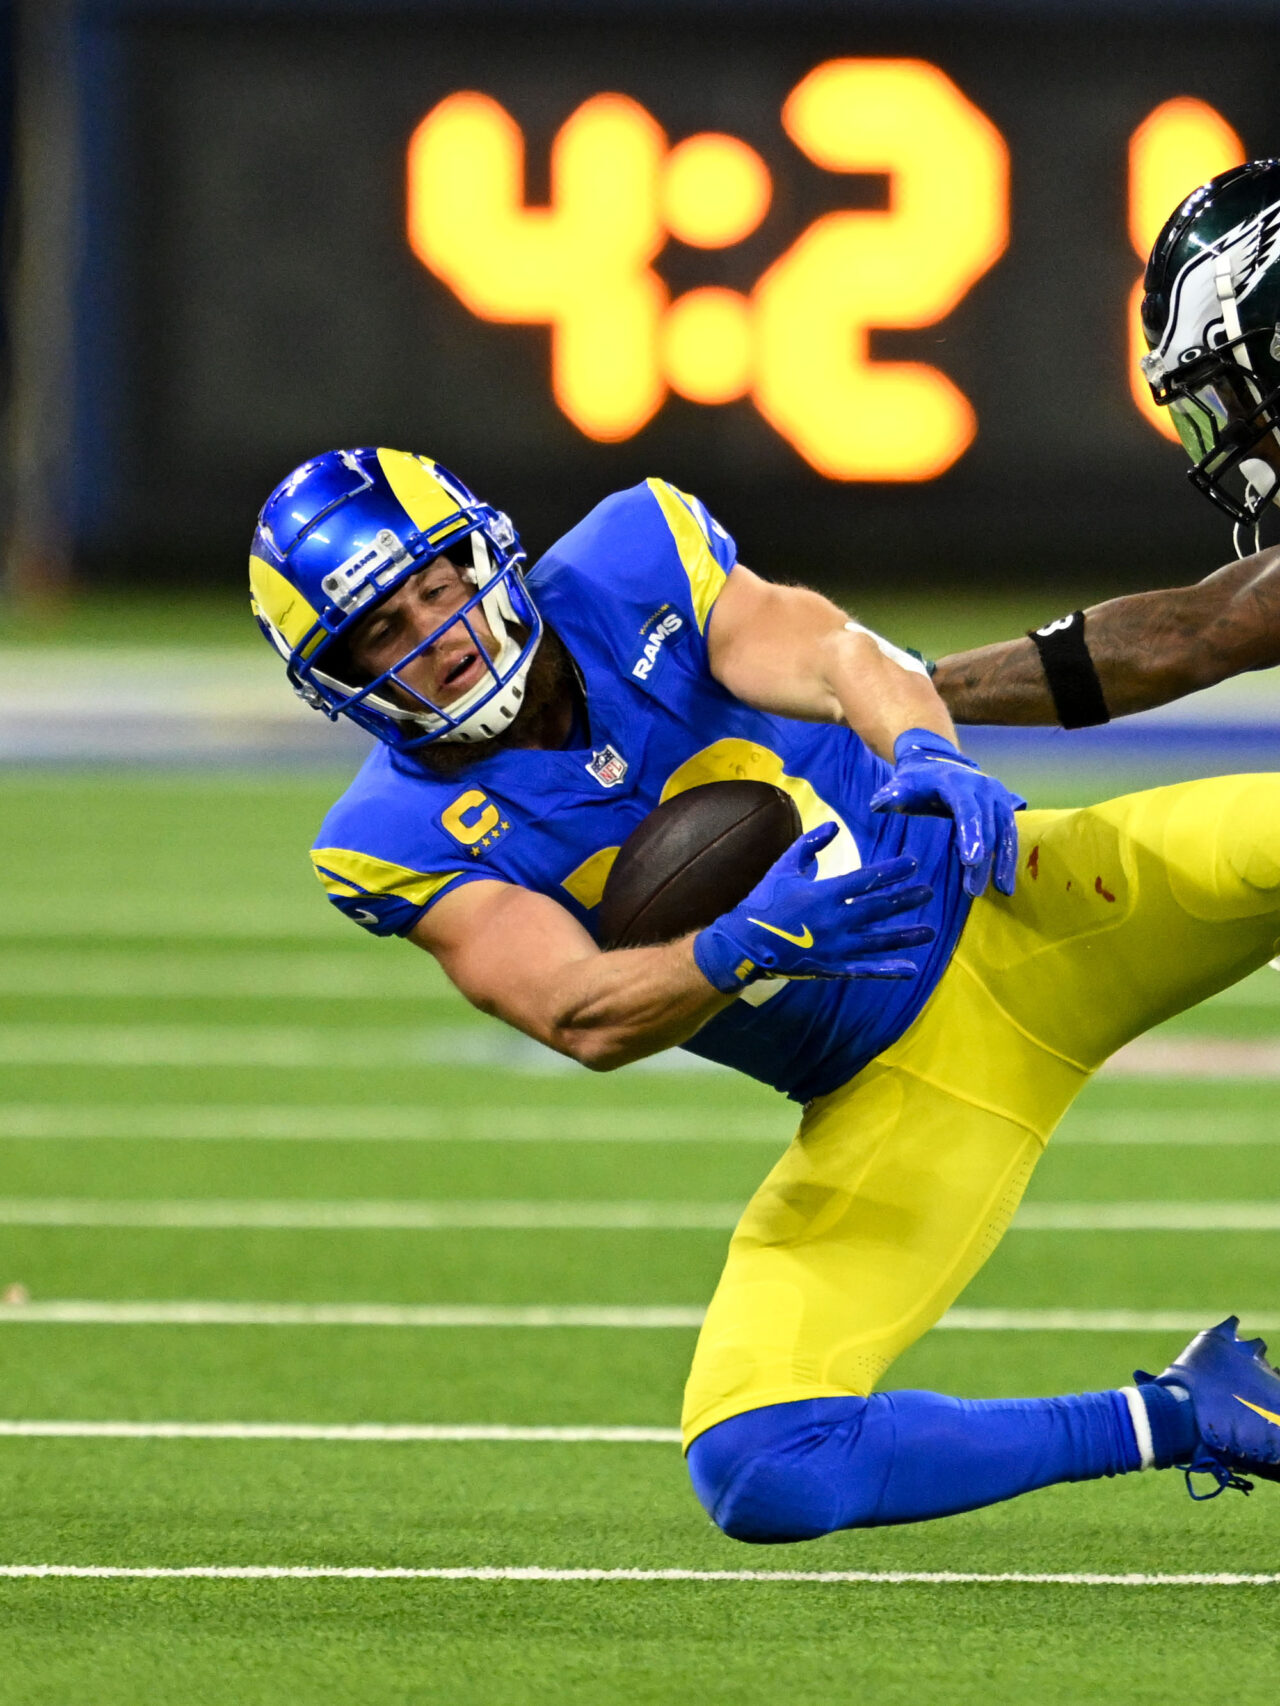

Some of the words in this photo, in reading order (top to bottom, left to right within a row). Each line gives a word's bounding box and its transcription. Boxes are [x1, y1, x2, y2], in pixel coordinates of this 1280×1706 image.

[345, 550, 378, 578] RAMS
[632, 613, 683, 681] RAMS
[599, 760, 623, 782] NFL
[441, 789, 499, 845] C
